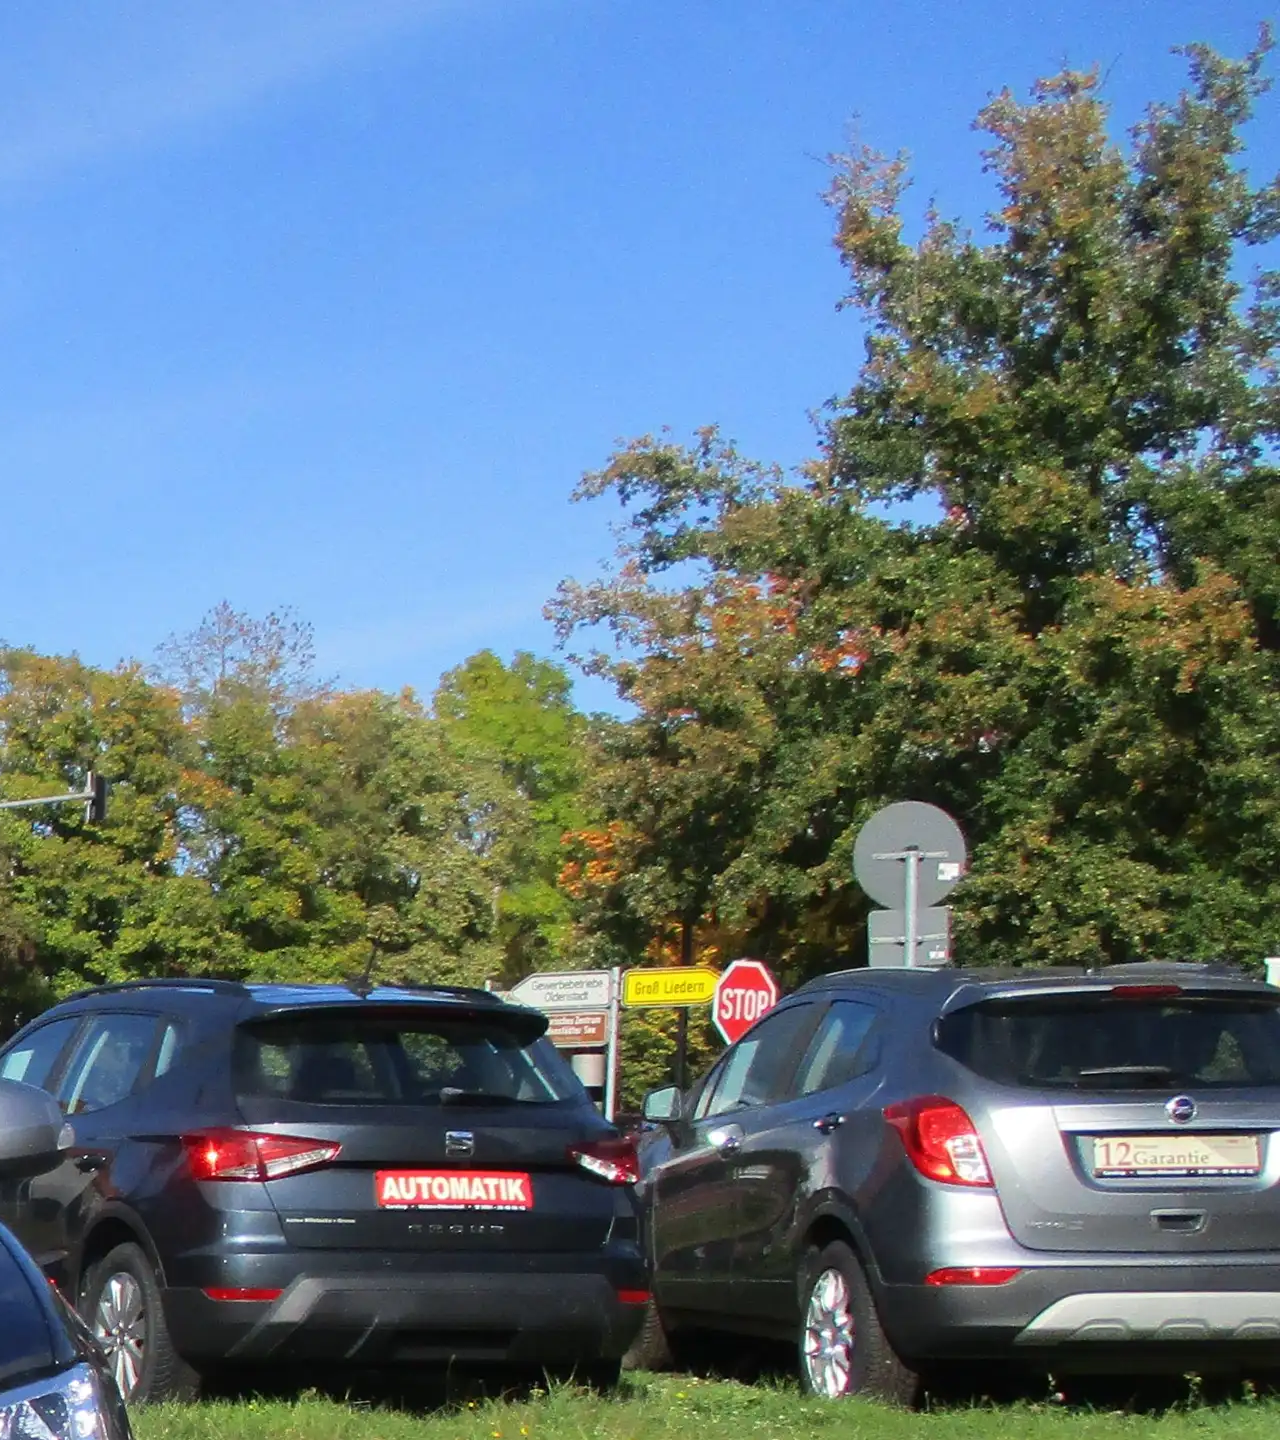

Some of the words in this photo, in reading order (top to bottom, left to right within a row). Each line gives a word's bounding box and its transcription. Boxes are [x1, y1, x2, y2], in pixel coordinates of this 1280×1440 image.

[635, 981, 660, 995] Groß
[664, 980, 705, 994] Liedern
[720, 989, 768, 1021] STOP
[1099, 1142, 1133, 1167] 12
[1134, 1150, 1210, 1165] Garantie
[383, 1176, 526, 1201] AUTOMATIK
